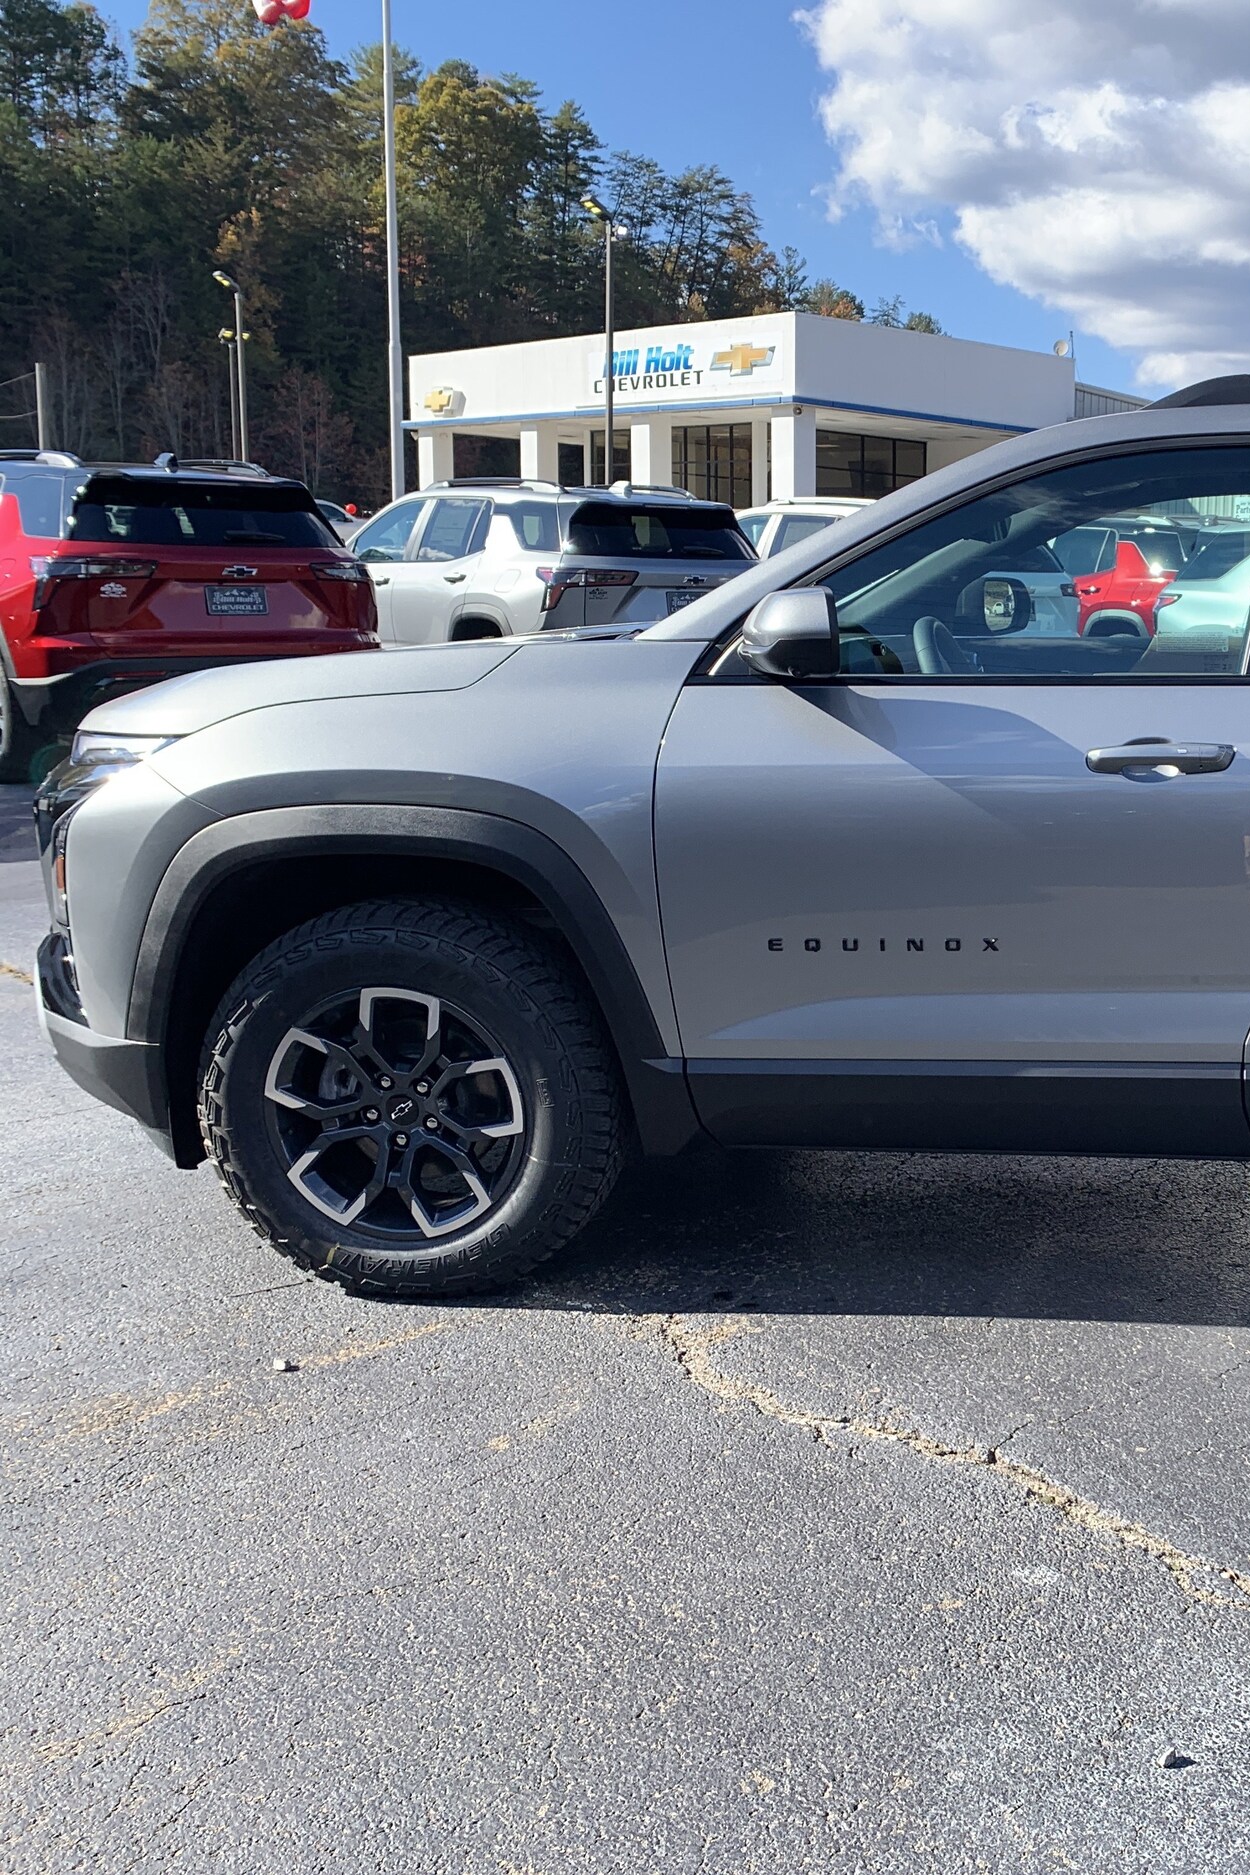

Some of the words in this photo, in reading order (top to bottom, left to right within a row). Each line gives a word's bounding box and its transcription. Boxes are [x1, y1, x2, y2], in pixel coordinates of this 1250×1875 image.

[603, 349, 639, 378] Bill
[644, 344, 694, 373] Holt
[767, 937, 1000, 952] EQUINOX
[337, 1223, 510, 1276] GENERAL
